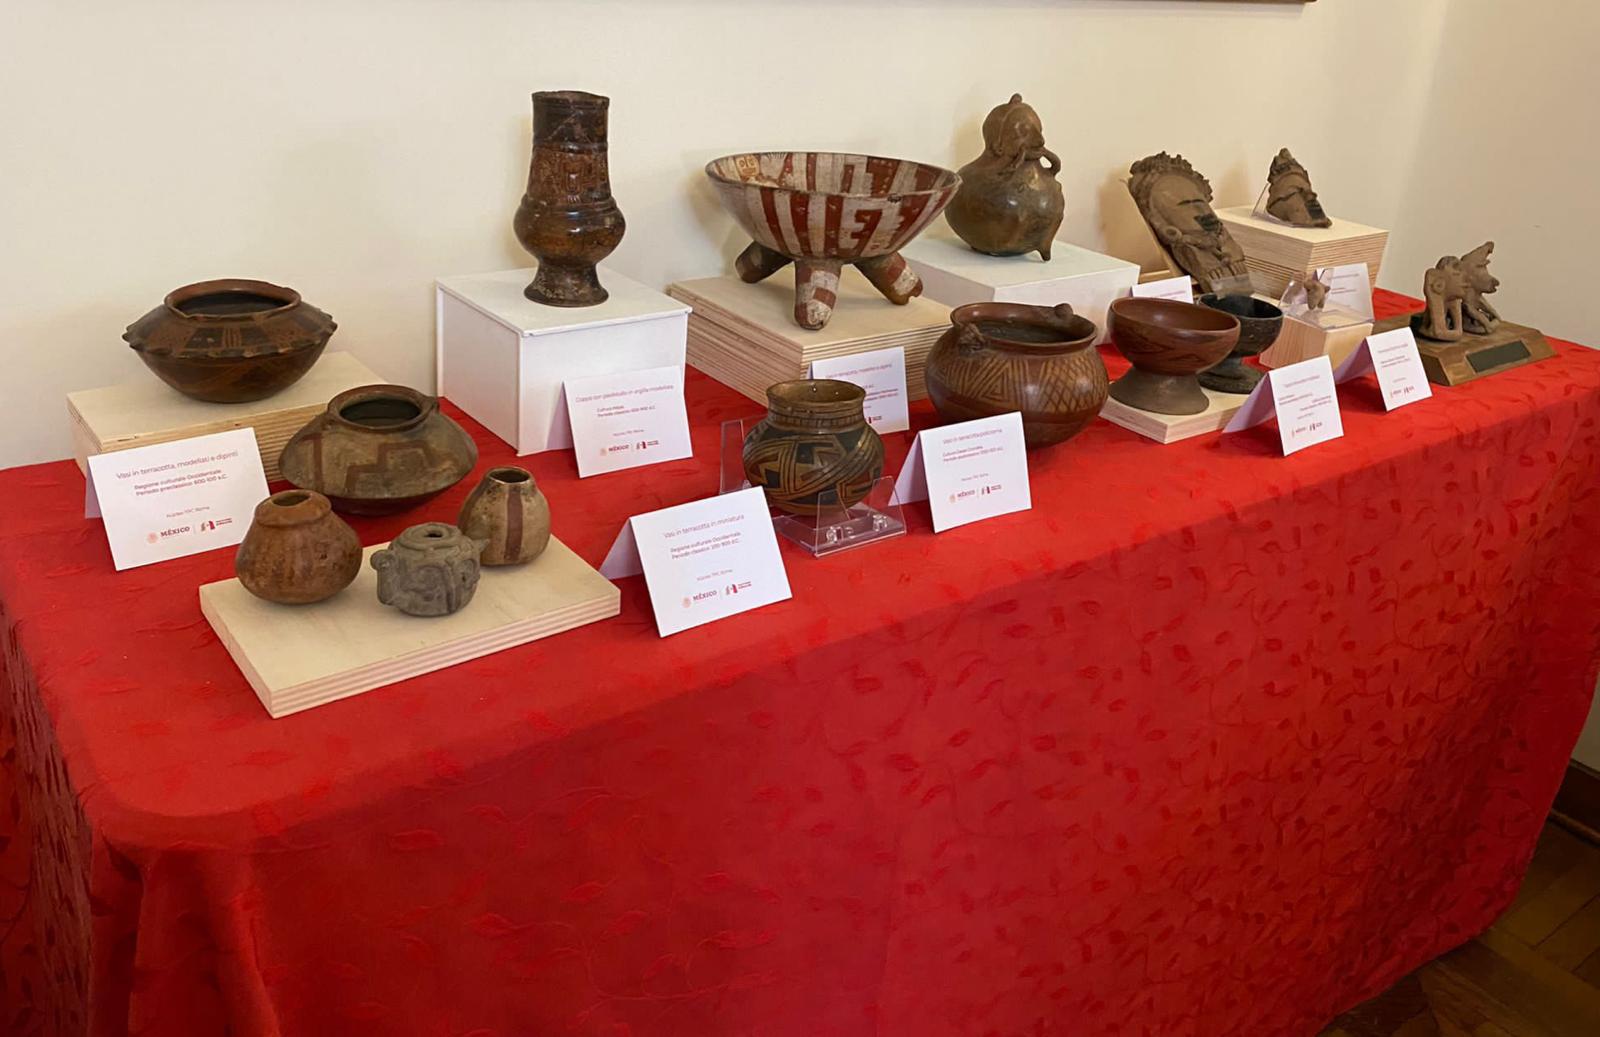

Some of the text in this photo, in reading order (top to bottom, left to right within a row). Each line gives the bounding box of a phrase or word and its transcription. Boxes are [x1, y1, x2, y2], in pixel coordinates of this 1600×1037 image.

[116, 470, 131, 479] Vasi
[177, 455, 209, 468] modellati
[215, 450, 238, 462] dipinti
[134, 470, 222, 491] Regione culturale Occidentale
[160, 482, 193, 492] preclassico
[160, 526, 190, 537] MÉXICO
[662, 529, 675, 539] Vasi
[682, 521, 710, 534] terracotta
[718, 513, 744, 525] miniatura
[670, 532, 741, 554] Regione culturale Occidentale
[671, 550, 690, 560] Periodo
[693, 589, 717, 600] MÉXICO
